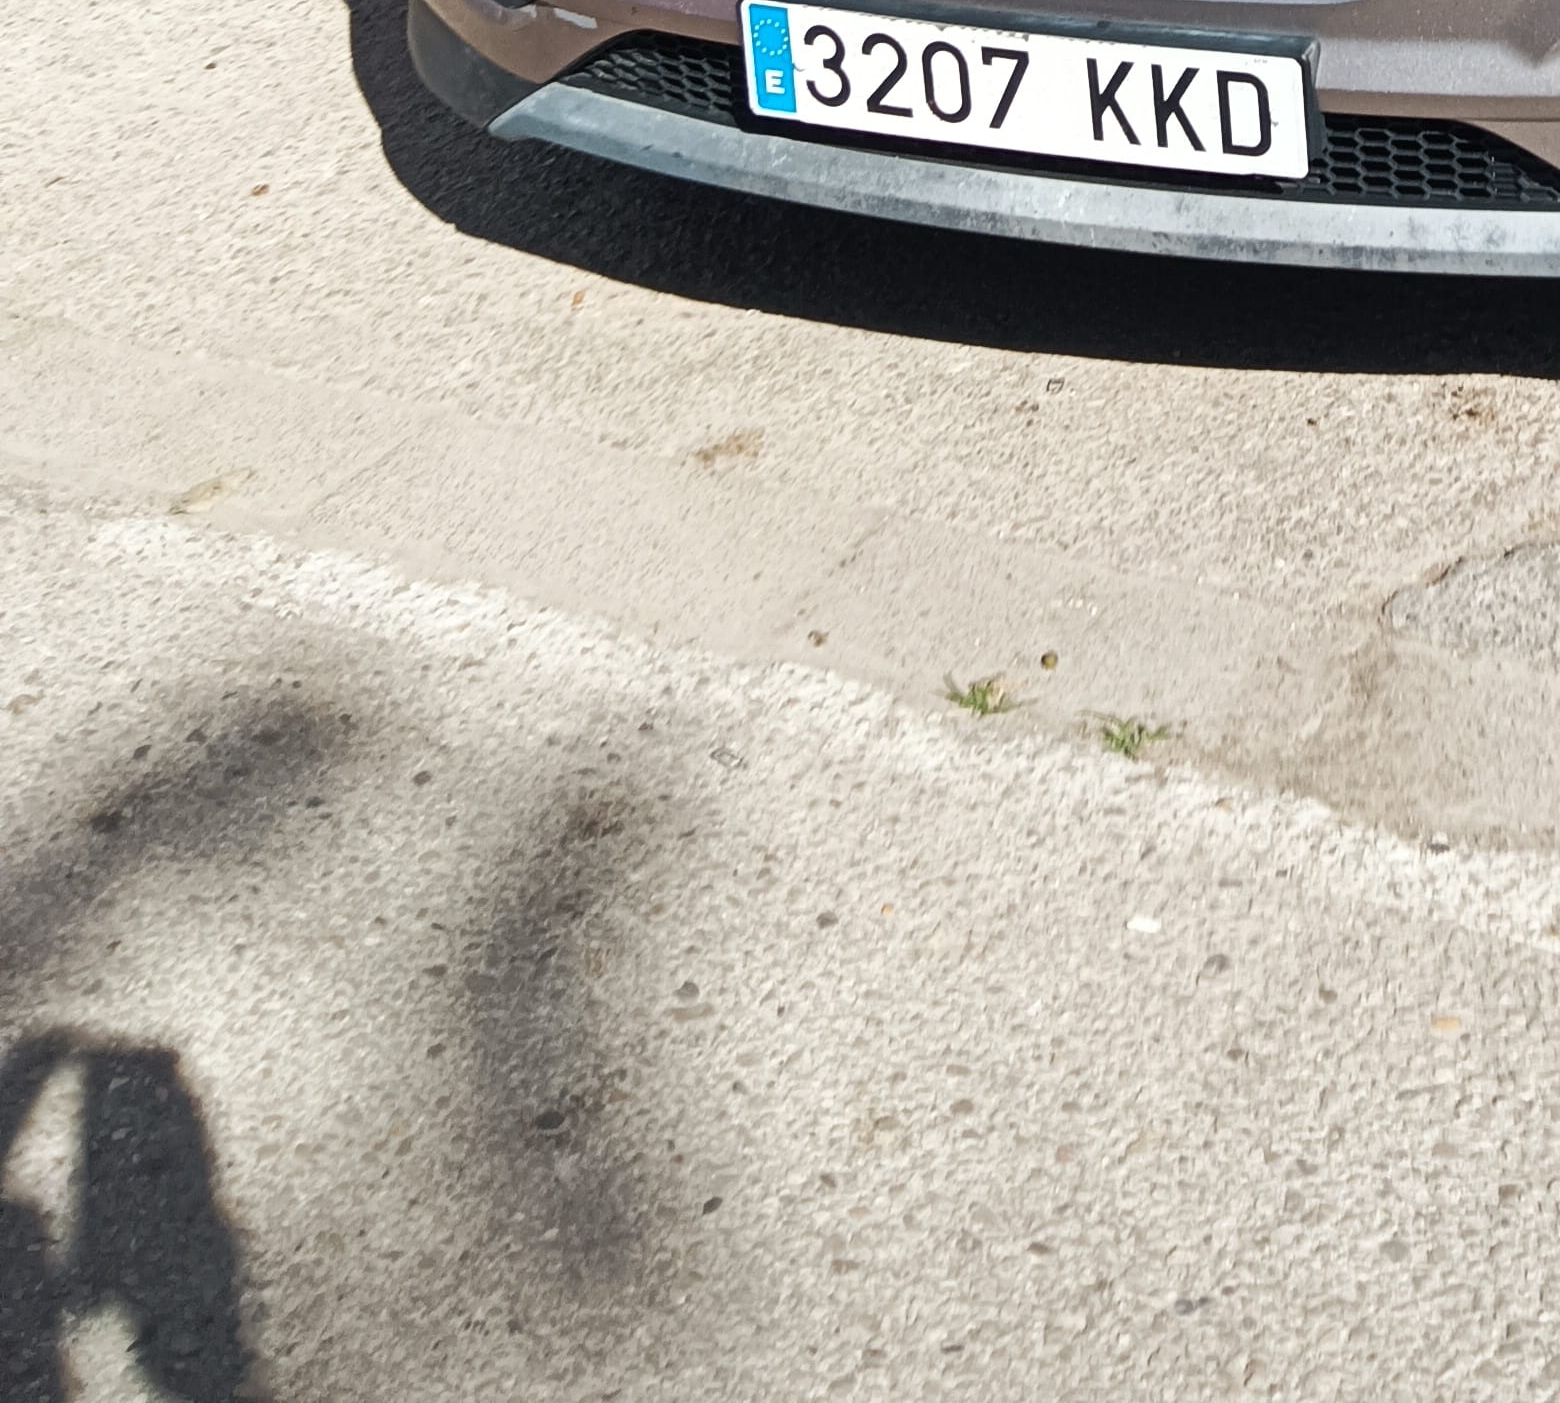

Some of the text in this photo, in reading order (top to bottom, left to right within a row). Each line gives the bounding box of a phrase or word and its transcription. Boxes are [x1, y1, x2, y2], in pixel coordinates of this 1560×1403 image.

[765, 24, 1273, 158] E 3207 KKD
